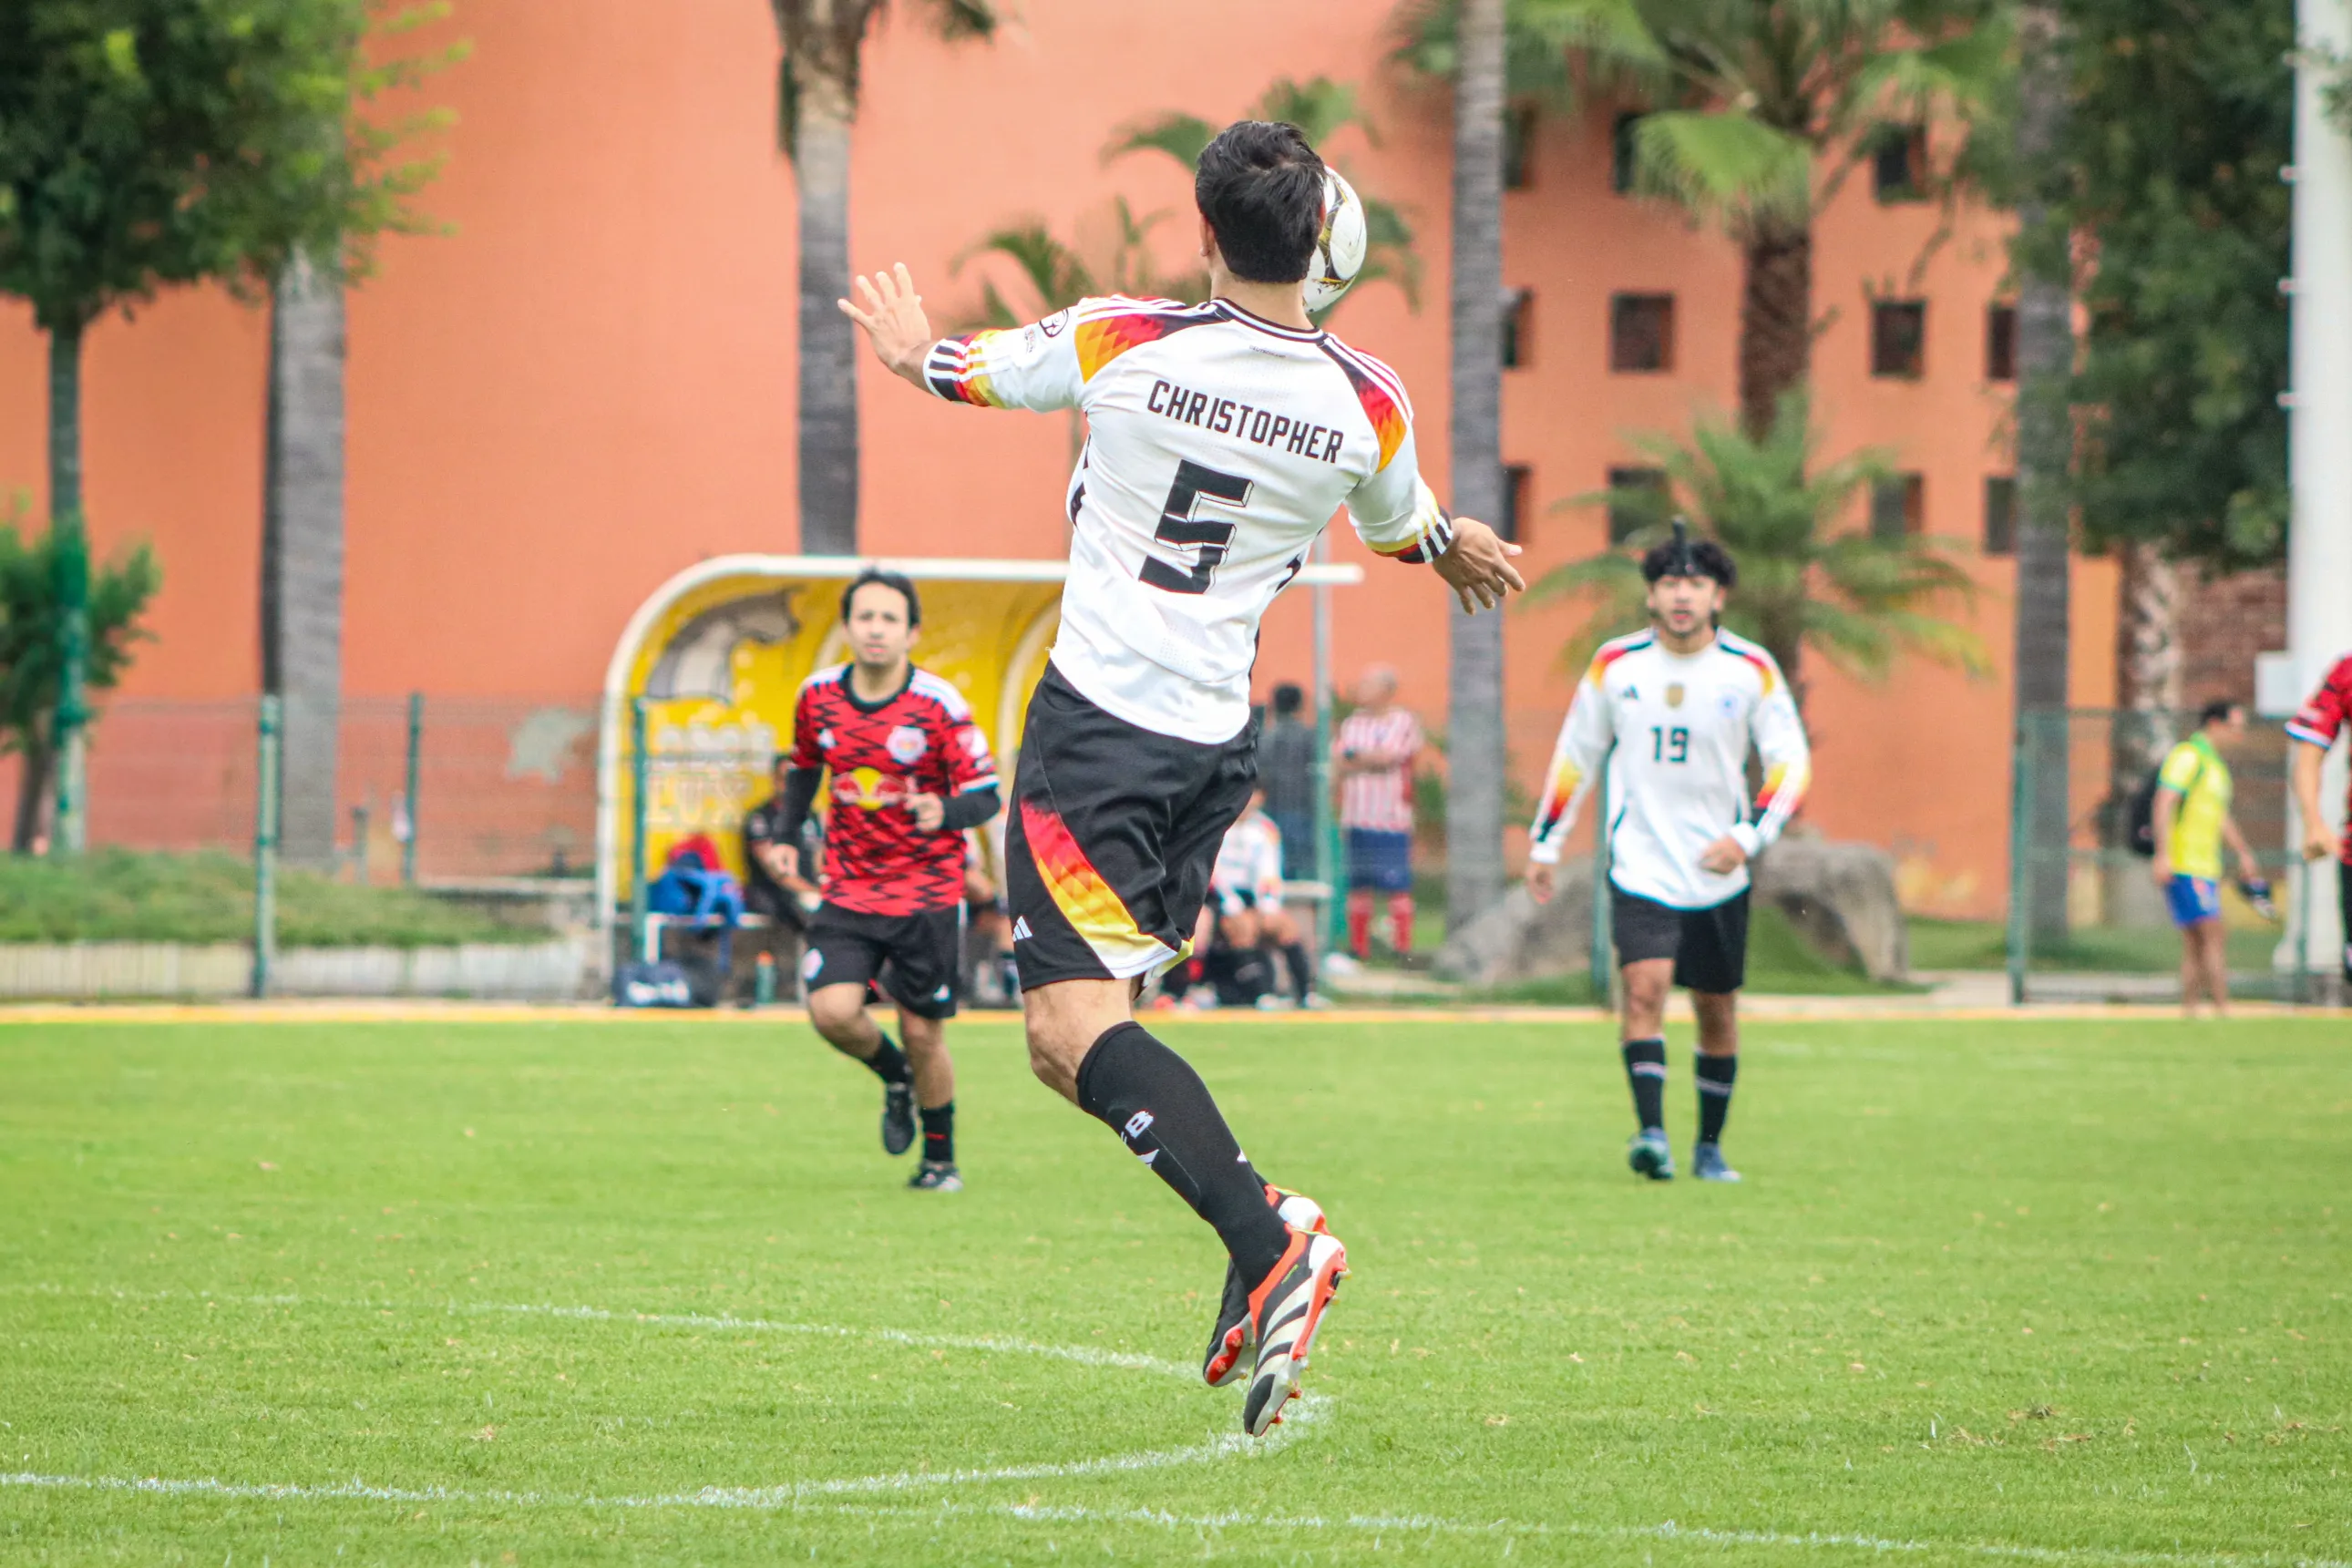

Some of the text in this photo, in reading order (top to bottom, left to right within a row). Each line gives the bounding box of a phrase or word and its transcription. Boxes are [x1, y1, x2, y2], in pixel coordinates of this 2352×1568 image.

[1146, 379, 1344, 464] CHRISTOPHER
[1138, 458, 1255, 595] 5
[1648, 725, 1689, 763] 19
